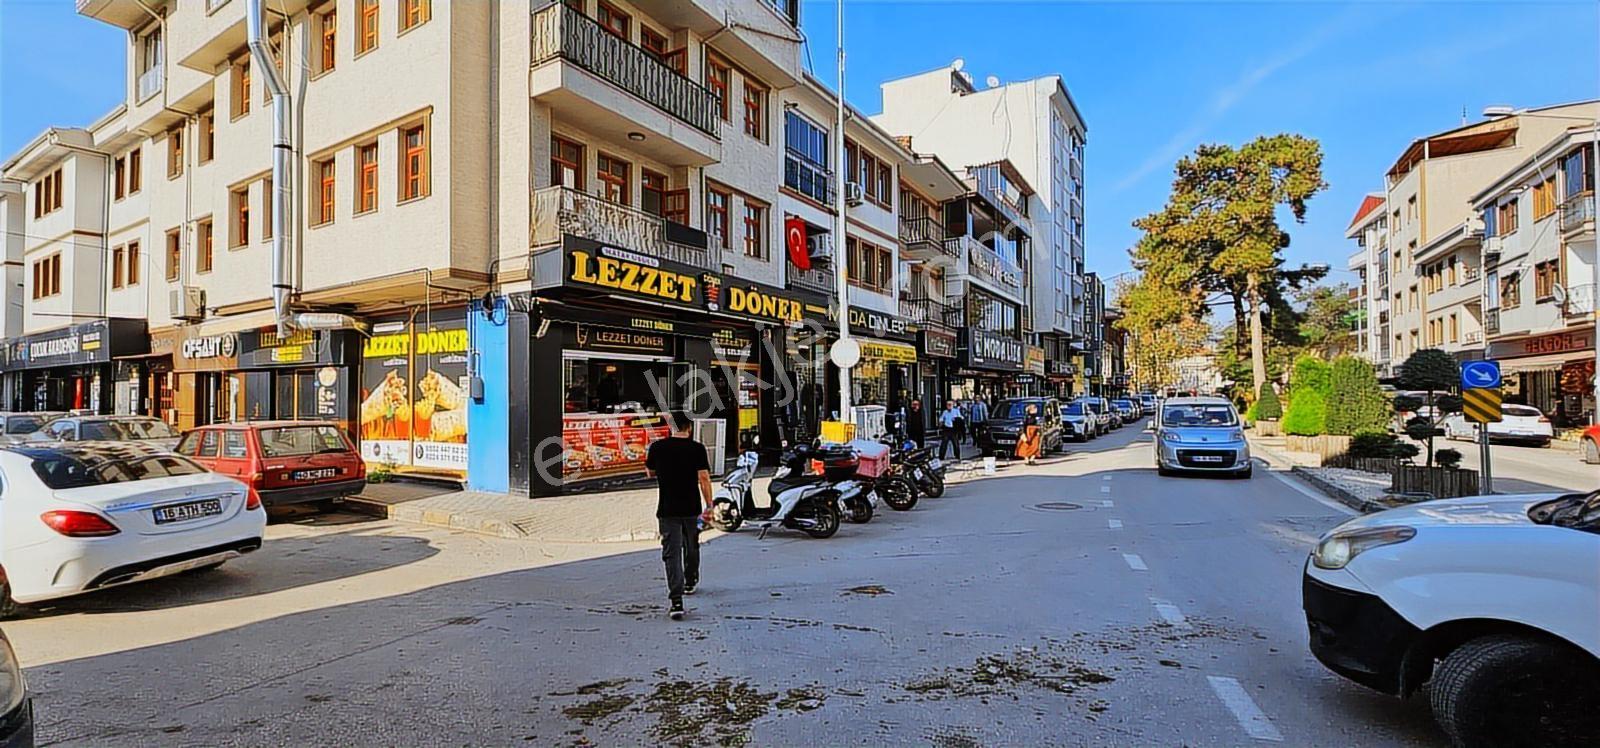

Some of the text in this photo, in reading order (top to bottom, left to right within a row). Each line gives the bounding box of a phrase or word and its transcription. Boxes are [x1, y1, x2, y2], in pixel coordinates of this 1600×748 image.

[571, 250, 804, 322] LEZZET DÖNER
[631, 318, 654, 329] LEZZET
[828, 304, 867, 328] MDA
[363, 326, 468, 358] LEZZET DÖNER
[596, 331, 632, 344] LEZZET
[163, 509, 175, 518] 16
[178, 504, 200, 517] ATH
[200, 502, 219, 512] 500
